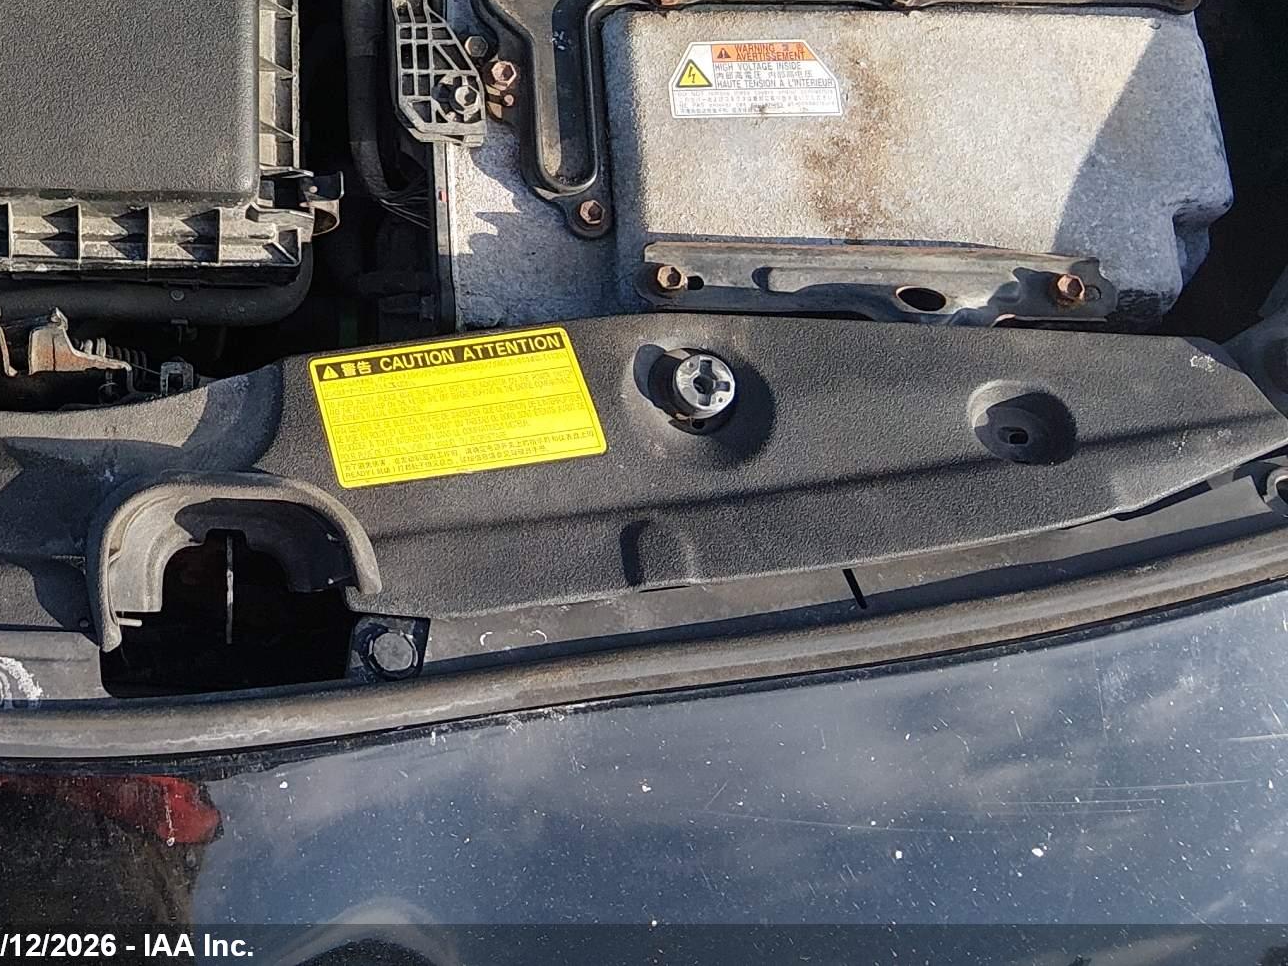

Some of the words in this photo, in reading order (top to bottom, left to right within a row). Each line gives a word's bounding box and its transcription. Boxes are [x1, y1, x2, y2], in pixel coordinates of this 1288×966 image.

[735, 43, 775, 52] WARNING
[736, 51, 806, 61] AVERTISSEMENT
[715, 63, 733, 71] HIGH
[738, 62, 772, 71] VOLTAGE
[776, 62, 801, 70] INSIDE
[717, 80, 741, 88] HAUTE
[744, 79, 776, 88] TENSION
[341, 360, 372, 377] 警告
[379, 349, 455, 374] CAUTION
[462, 334, 561, 362] ATTENTION
